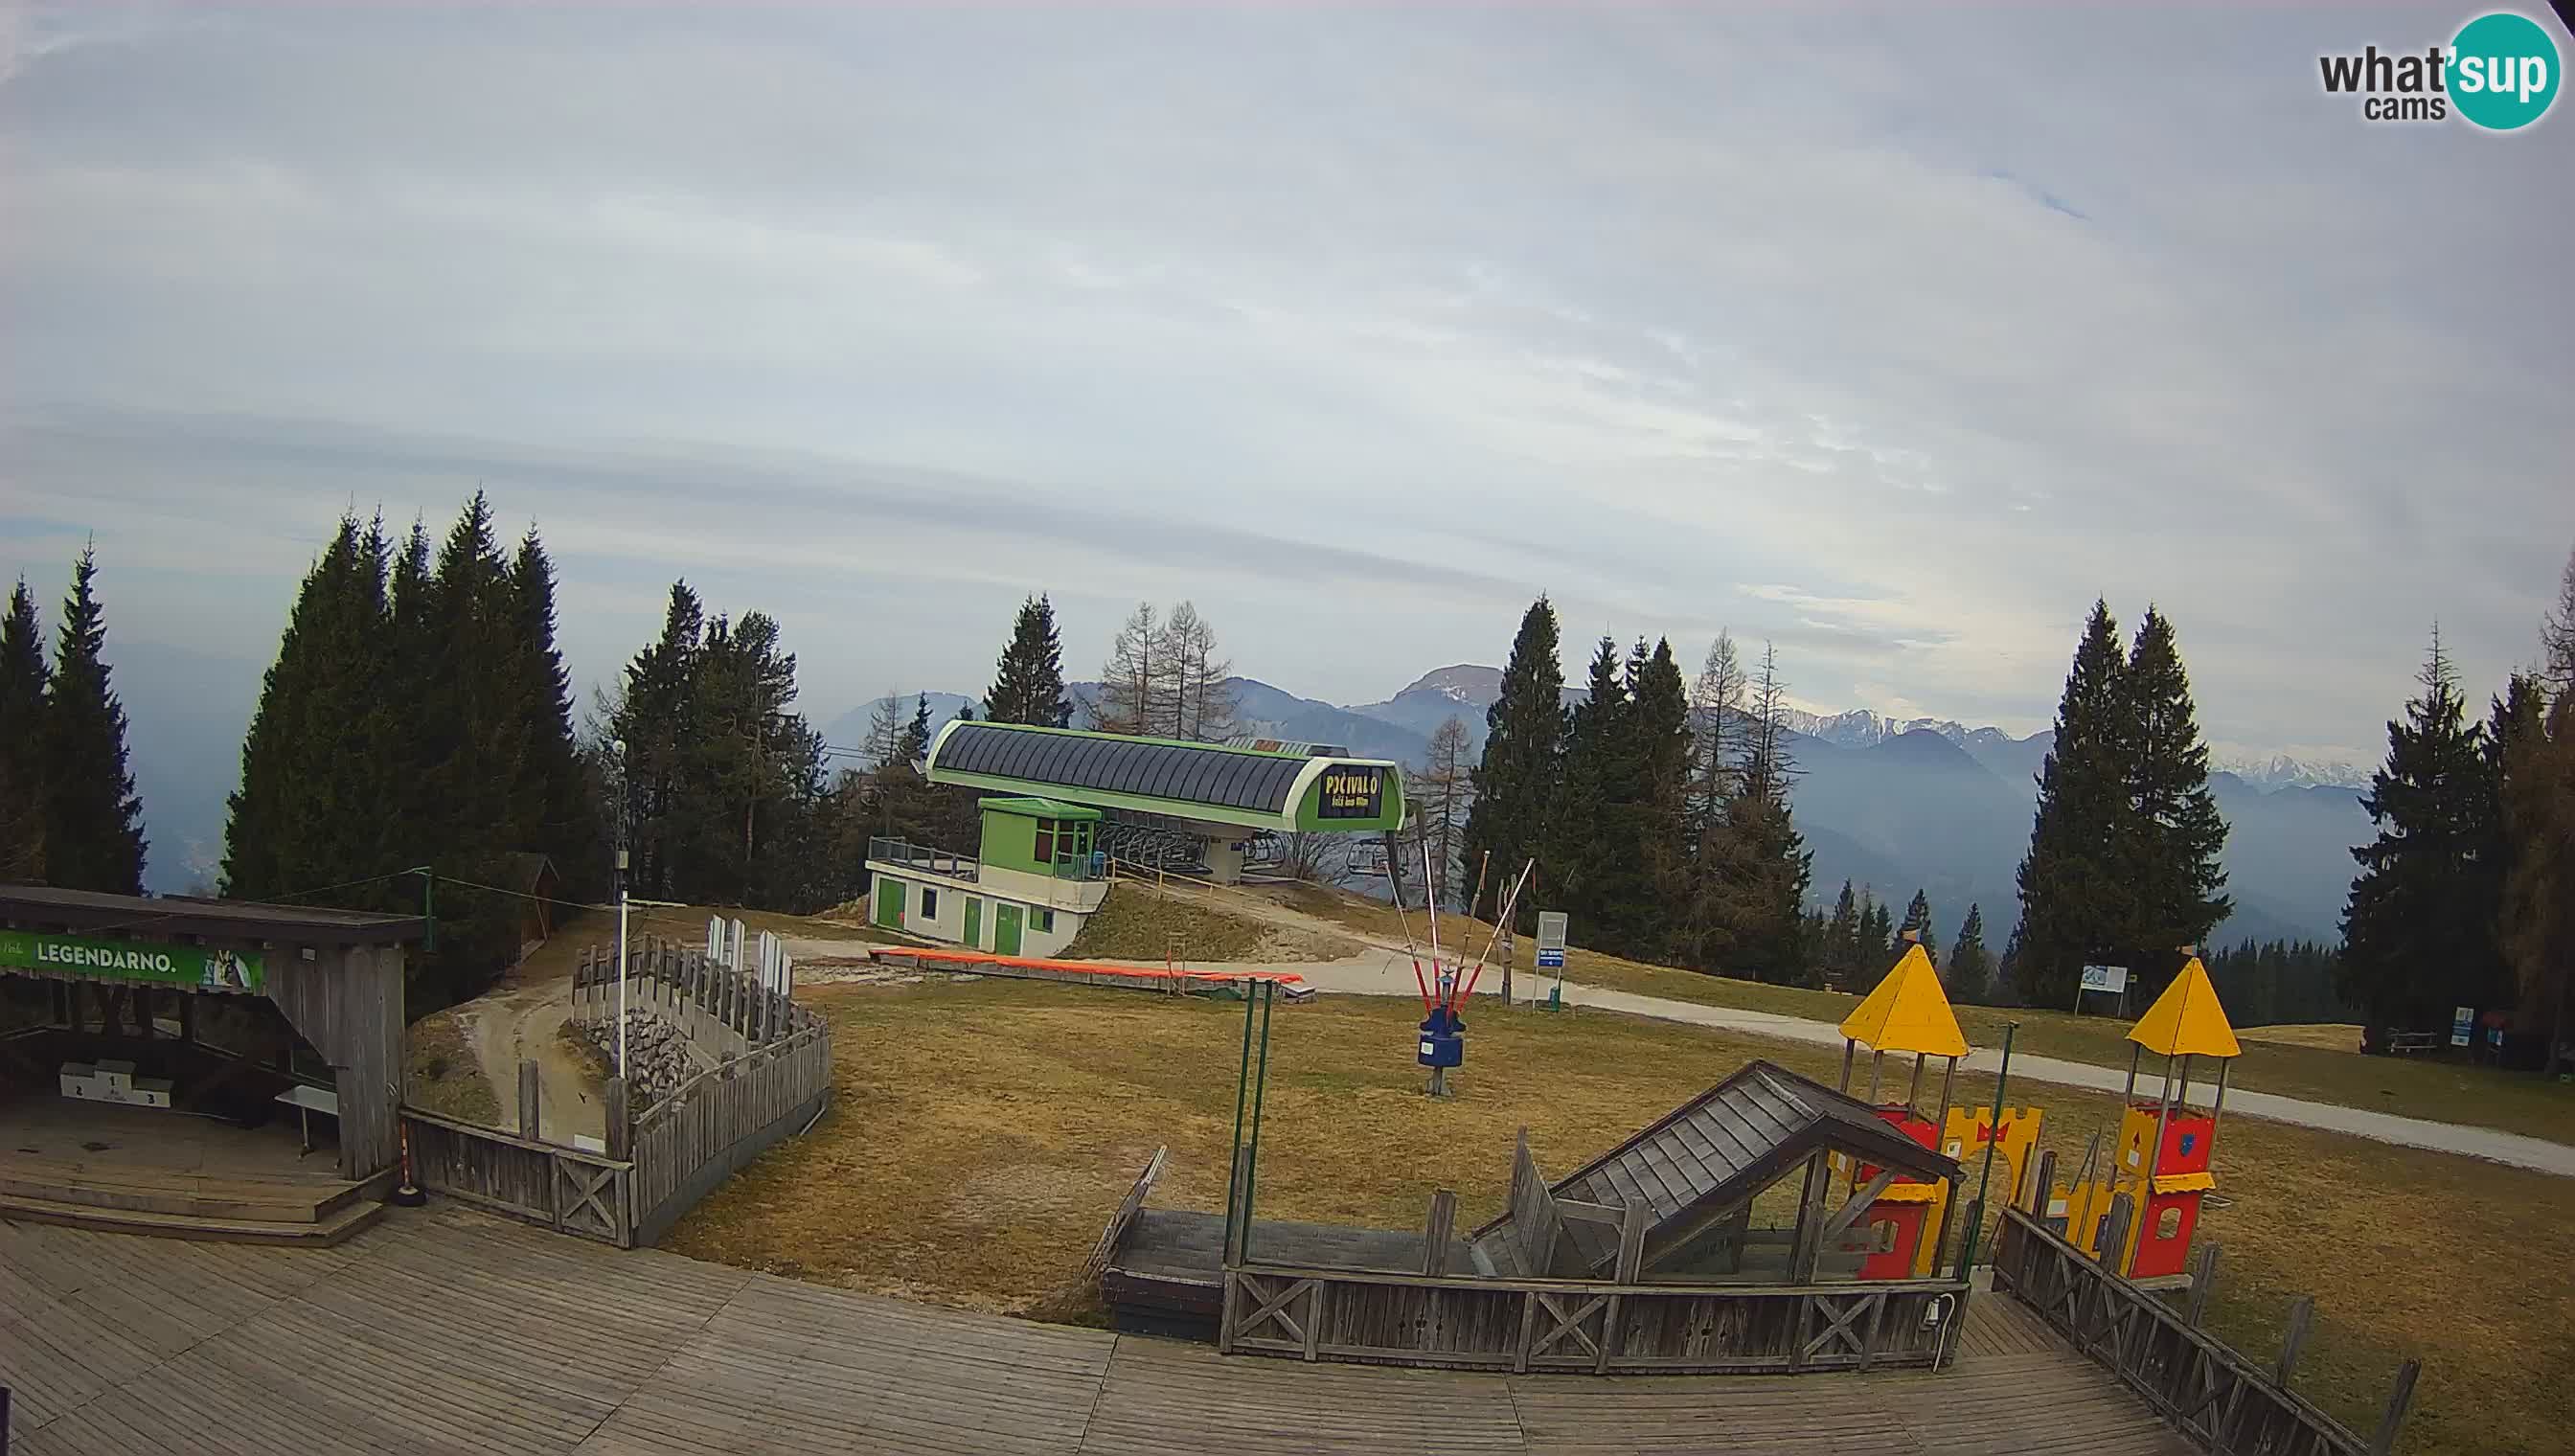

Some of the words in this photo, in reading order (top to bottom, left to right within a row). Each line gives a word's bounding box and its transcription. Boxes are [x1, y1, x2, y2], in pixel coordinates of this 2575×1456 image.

[36, 942, 176, 973] LEGENDARNO.
[76, 1086, 83, 1097] 2
[148, 1094, 155, 1104] 3
